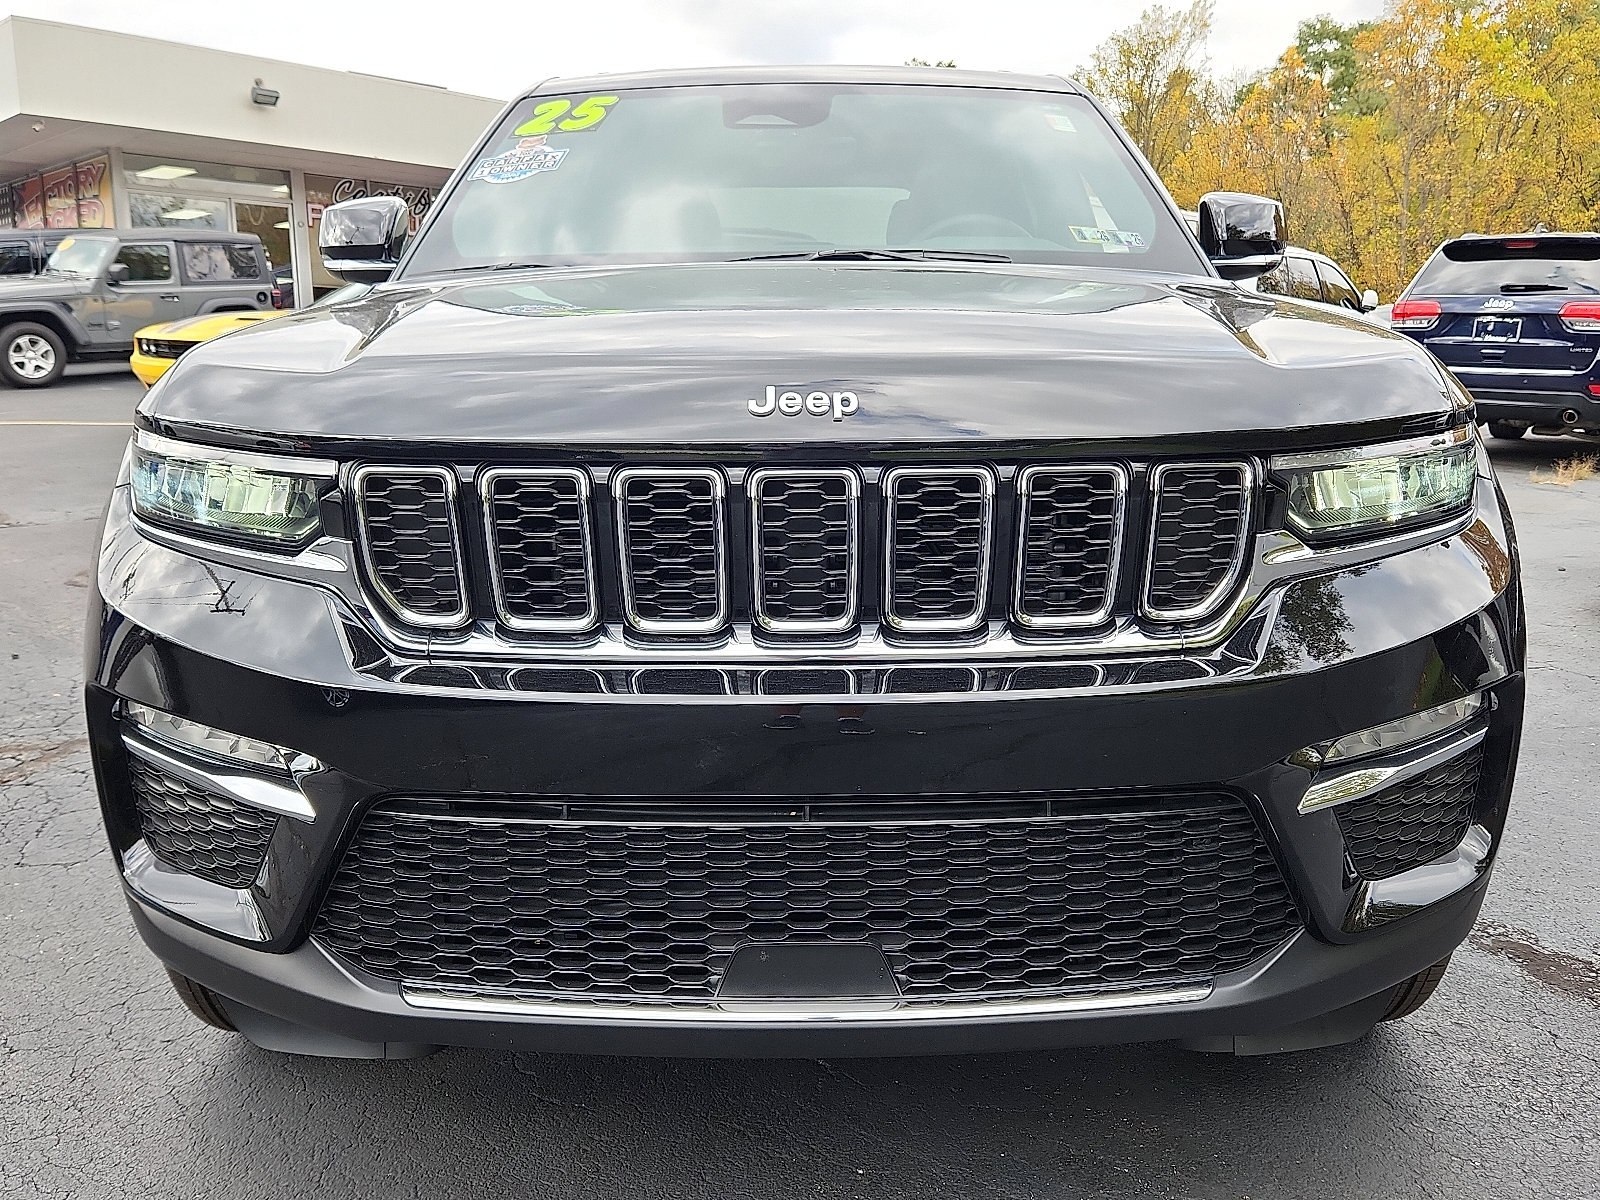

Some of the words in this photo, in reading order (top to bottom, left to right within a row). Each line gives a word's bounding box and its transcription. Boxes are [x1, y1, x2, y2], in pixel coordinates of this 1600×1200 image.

[514, 96, 620, 136] 25
[481, 153, 560, 168] CARFAX
[1483, 297, 1515, 310] Jeep
[747, 384, 860, 422] Jeep
